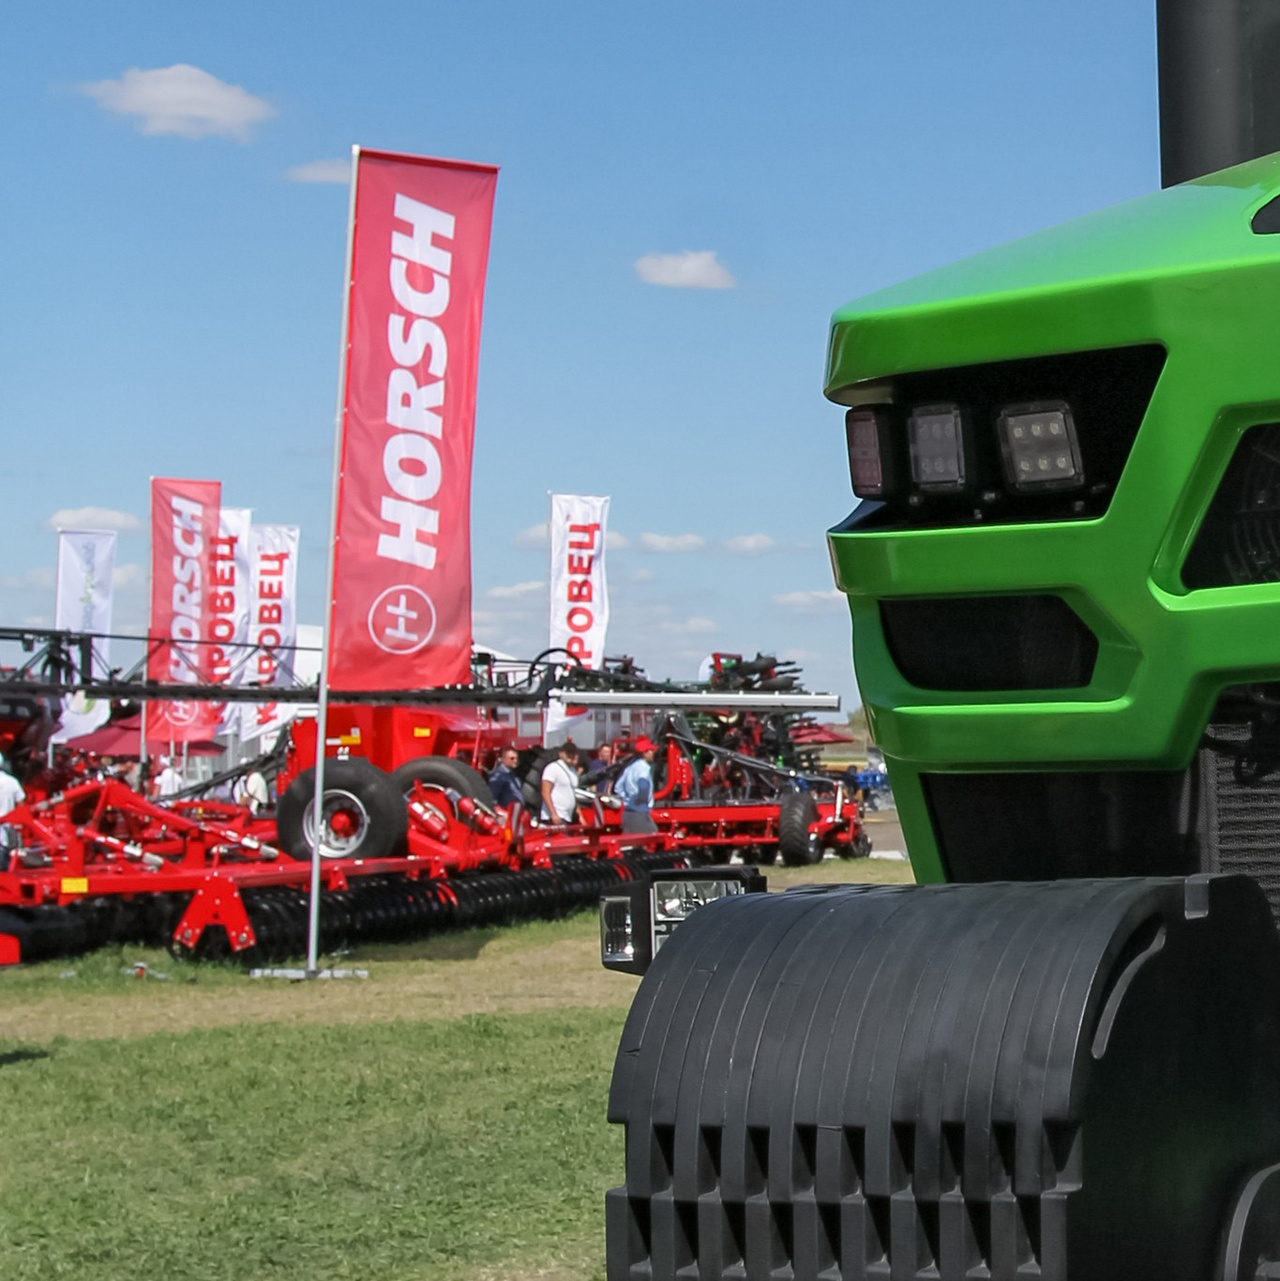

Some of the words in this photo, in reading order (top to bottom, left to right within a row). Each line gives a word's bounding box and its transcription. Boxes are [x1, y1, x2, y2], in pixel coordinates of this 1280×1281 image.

[376, 193, 455, 570] HORSCH
[170, 495, 204, 684] HORSCH
[566, 523, 600, 717] РОВЕЦ
